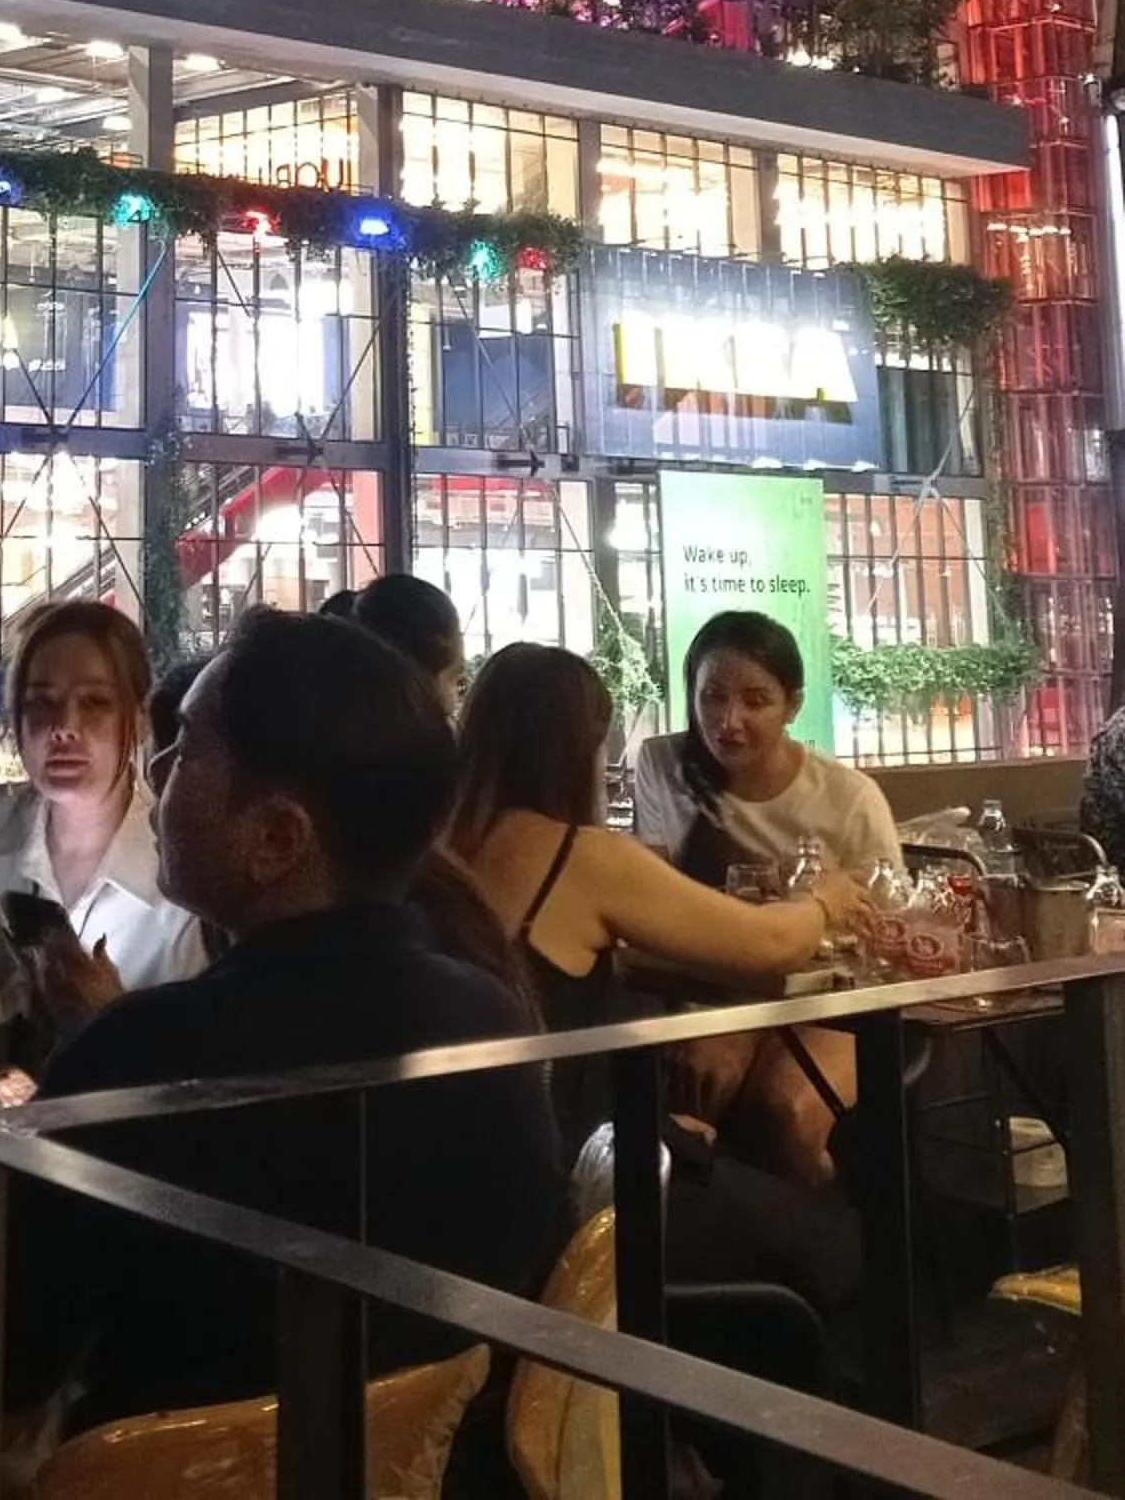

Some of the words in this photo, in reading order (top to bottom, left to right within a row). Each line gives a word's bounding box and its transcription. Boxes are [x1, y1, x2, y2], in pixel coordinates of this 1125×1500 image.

[683, 545, 724, 563] Wake
[684, 573, 707, 593] it's
[712, 576, 746, 593] time
[750, 577, 766, 593] to
[768, 574, 811, 598] sleep.
